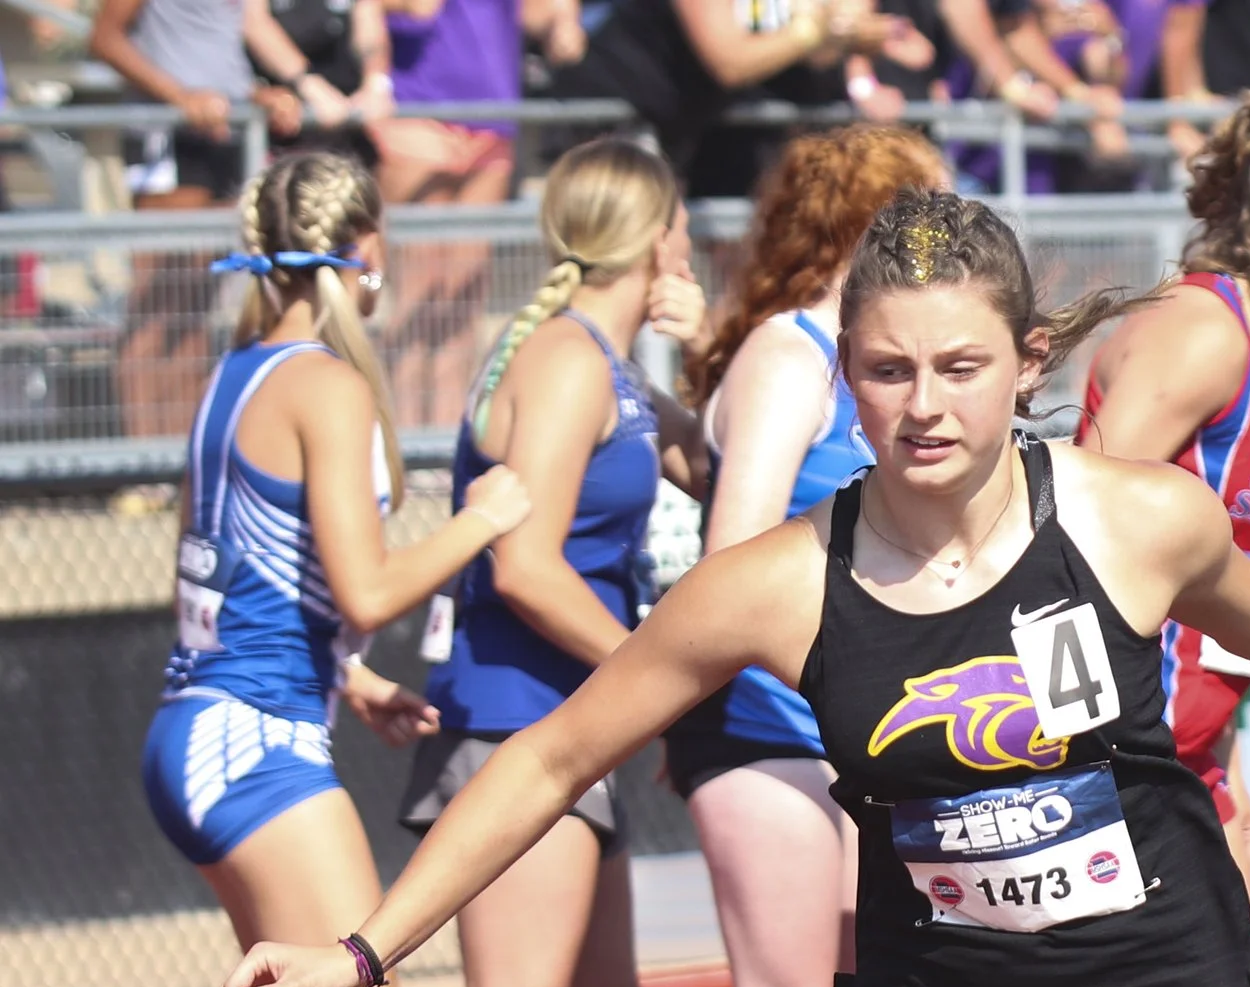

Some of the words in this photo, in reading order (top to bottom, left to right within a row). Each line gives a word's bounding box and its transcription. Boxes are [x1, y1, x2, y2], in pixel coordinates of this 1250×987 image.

[1048, 619, 1103, 720] 4
[934, 795, 1073, 851] ZERO
[960, 789, 1036, 817] SHOW-ME
[976, 867, 1072, 907] 1473
